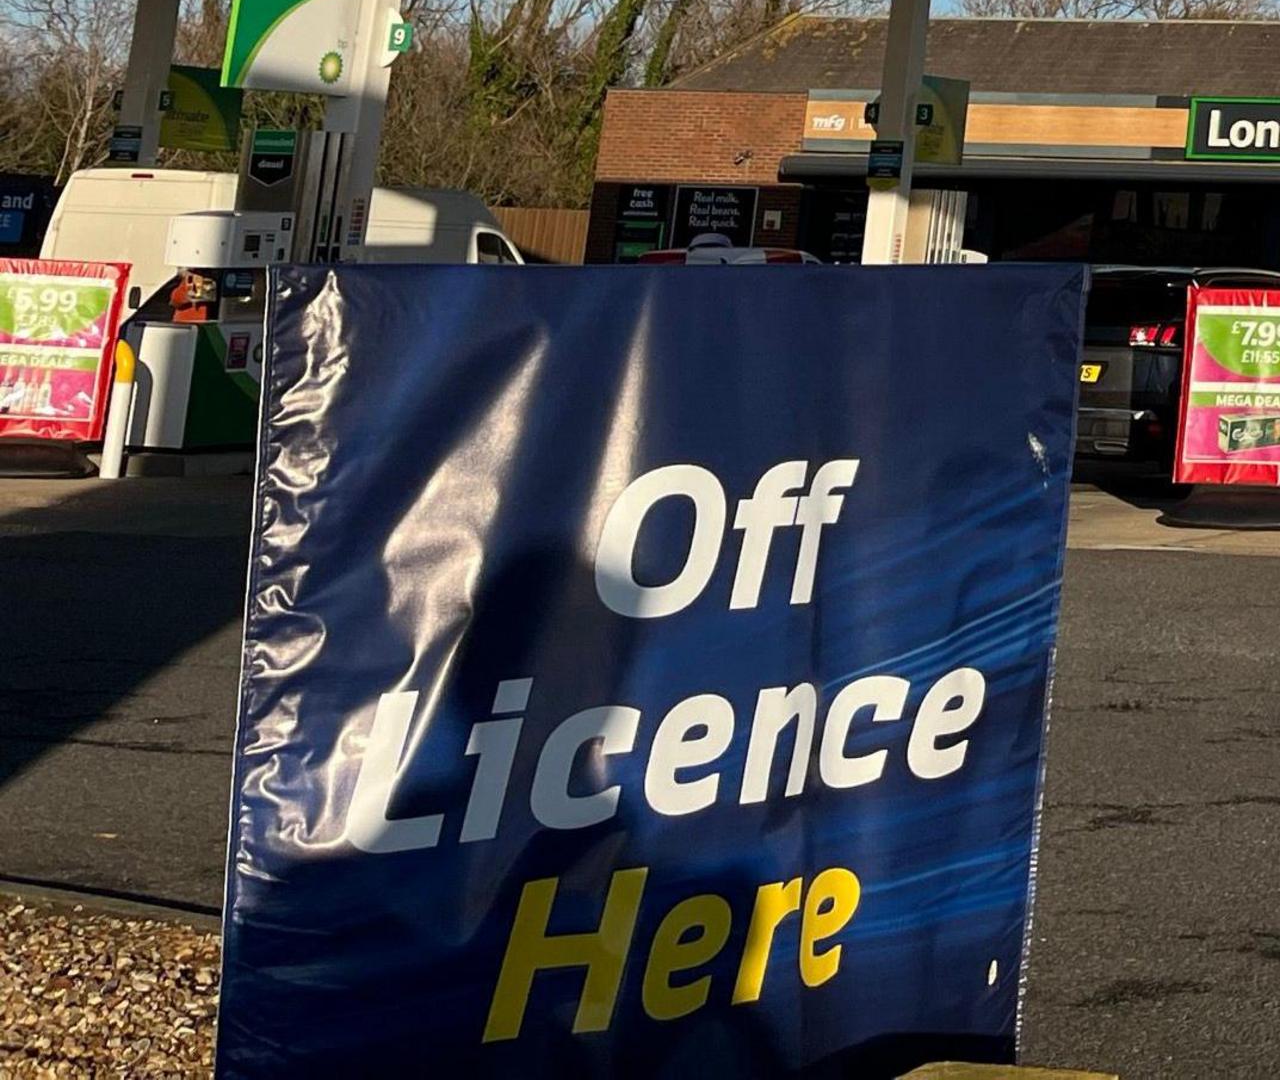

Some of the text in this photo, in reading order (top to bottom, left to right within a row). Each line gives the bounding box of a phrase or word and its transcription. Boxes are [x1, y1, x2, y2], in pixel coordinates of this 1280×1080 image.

[393, 27, 406, 46] 9
[920, 107, 929, 120] 3
[633, 187, 654, 198] free
[693, 191, 714, 203] Real
[1, 192, 35, 210] and
[629, 199, 654, 209] cash
[689, 203, 710, 215] Real
[688, 216, 709, 227] Real
[0, 354, 27, 366] EGA
[1215, 394, 1252, 407] MEGA
[594, 457, 860, 619] Off
[346, 665, 986, 854] Licence
[481, 866, 862, 1045] Here
